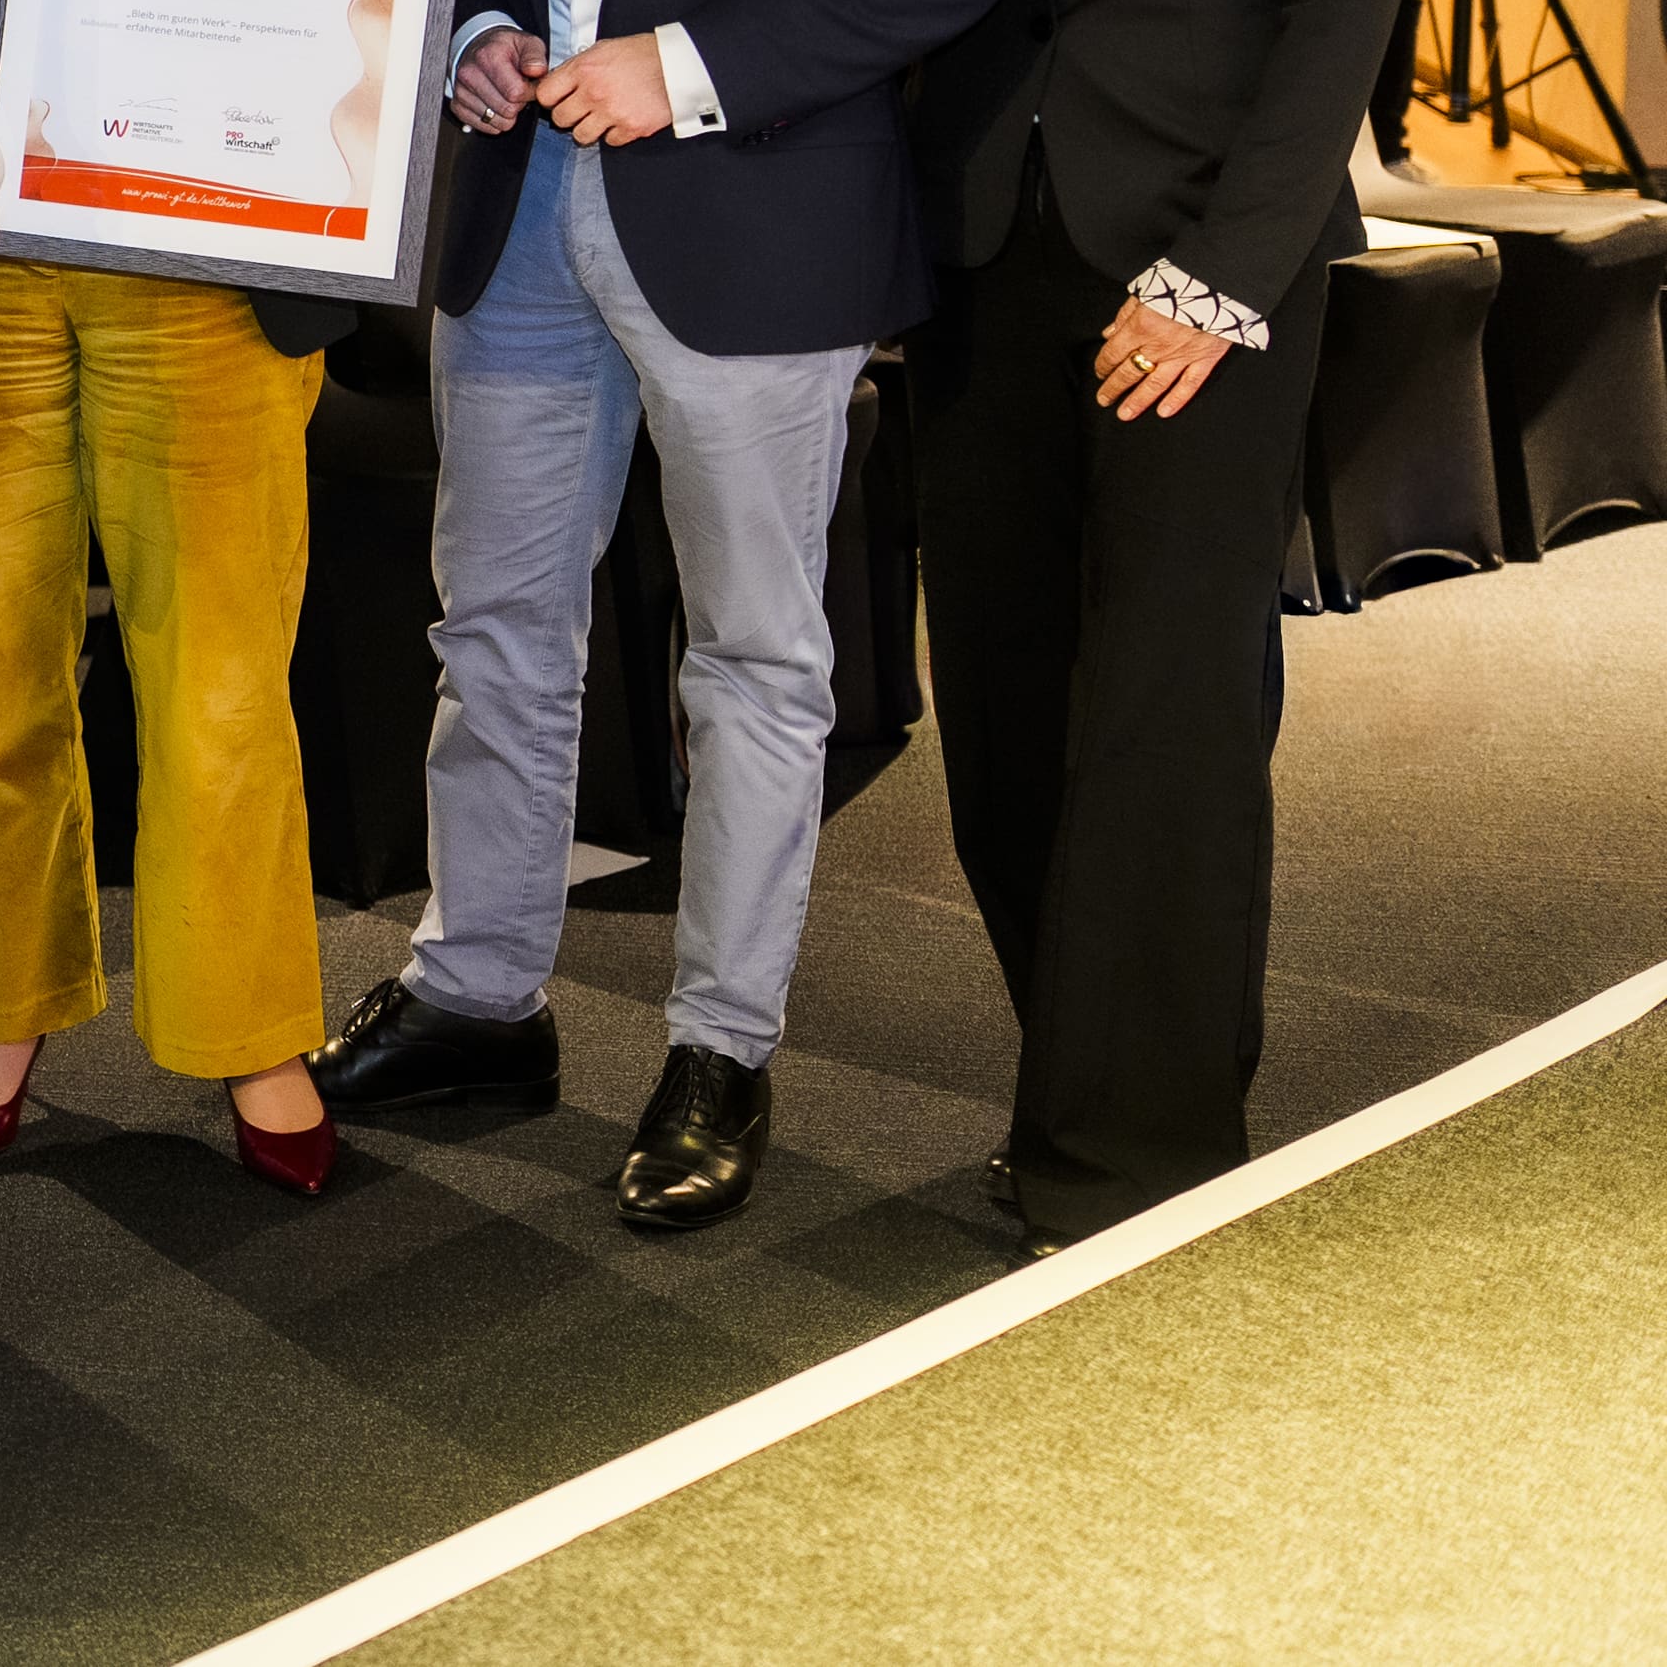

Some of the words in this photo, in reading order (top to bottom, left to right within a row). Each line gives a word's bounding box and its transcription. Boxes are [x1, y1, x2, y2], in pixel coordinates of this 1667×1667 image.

[125, 22, 172, 36] erfahrene
[174, 28, 243, 44] Mitarbeitende
[156, 13, 170, 22] im
[171, 14, 199, 26] guten
[239, 21, 301, 38] Perspektiven
[303, 27, 319, 39] für
[225, 130, 244, 139] PRO
[121, 188, 252, 210] www.prowi-gt.de/wettbewerb
